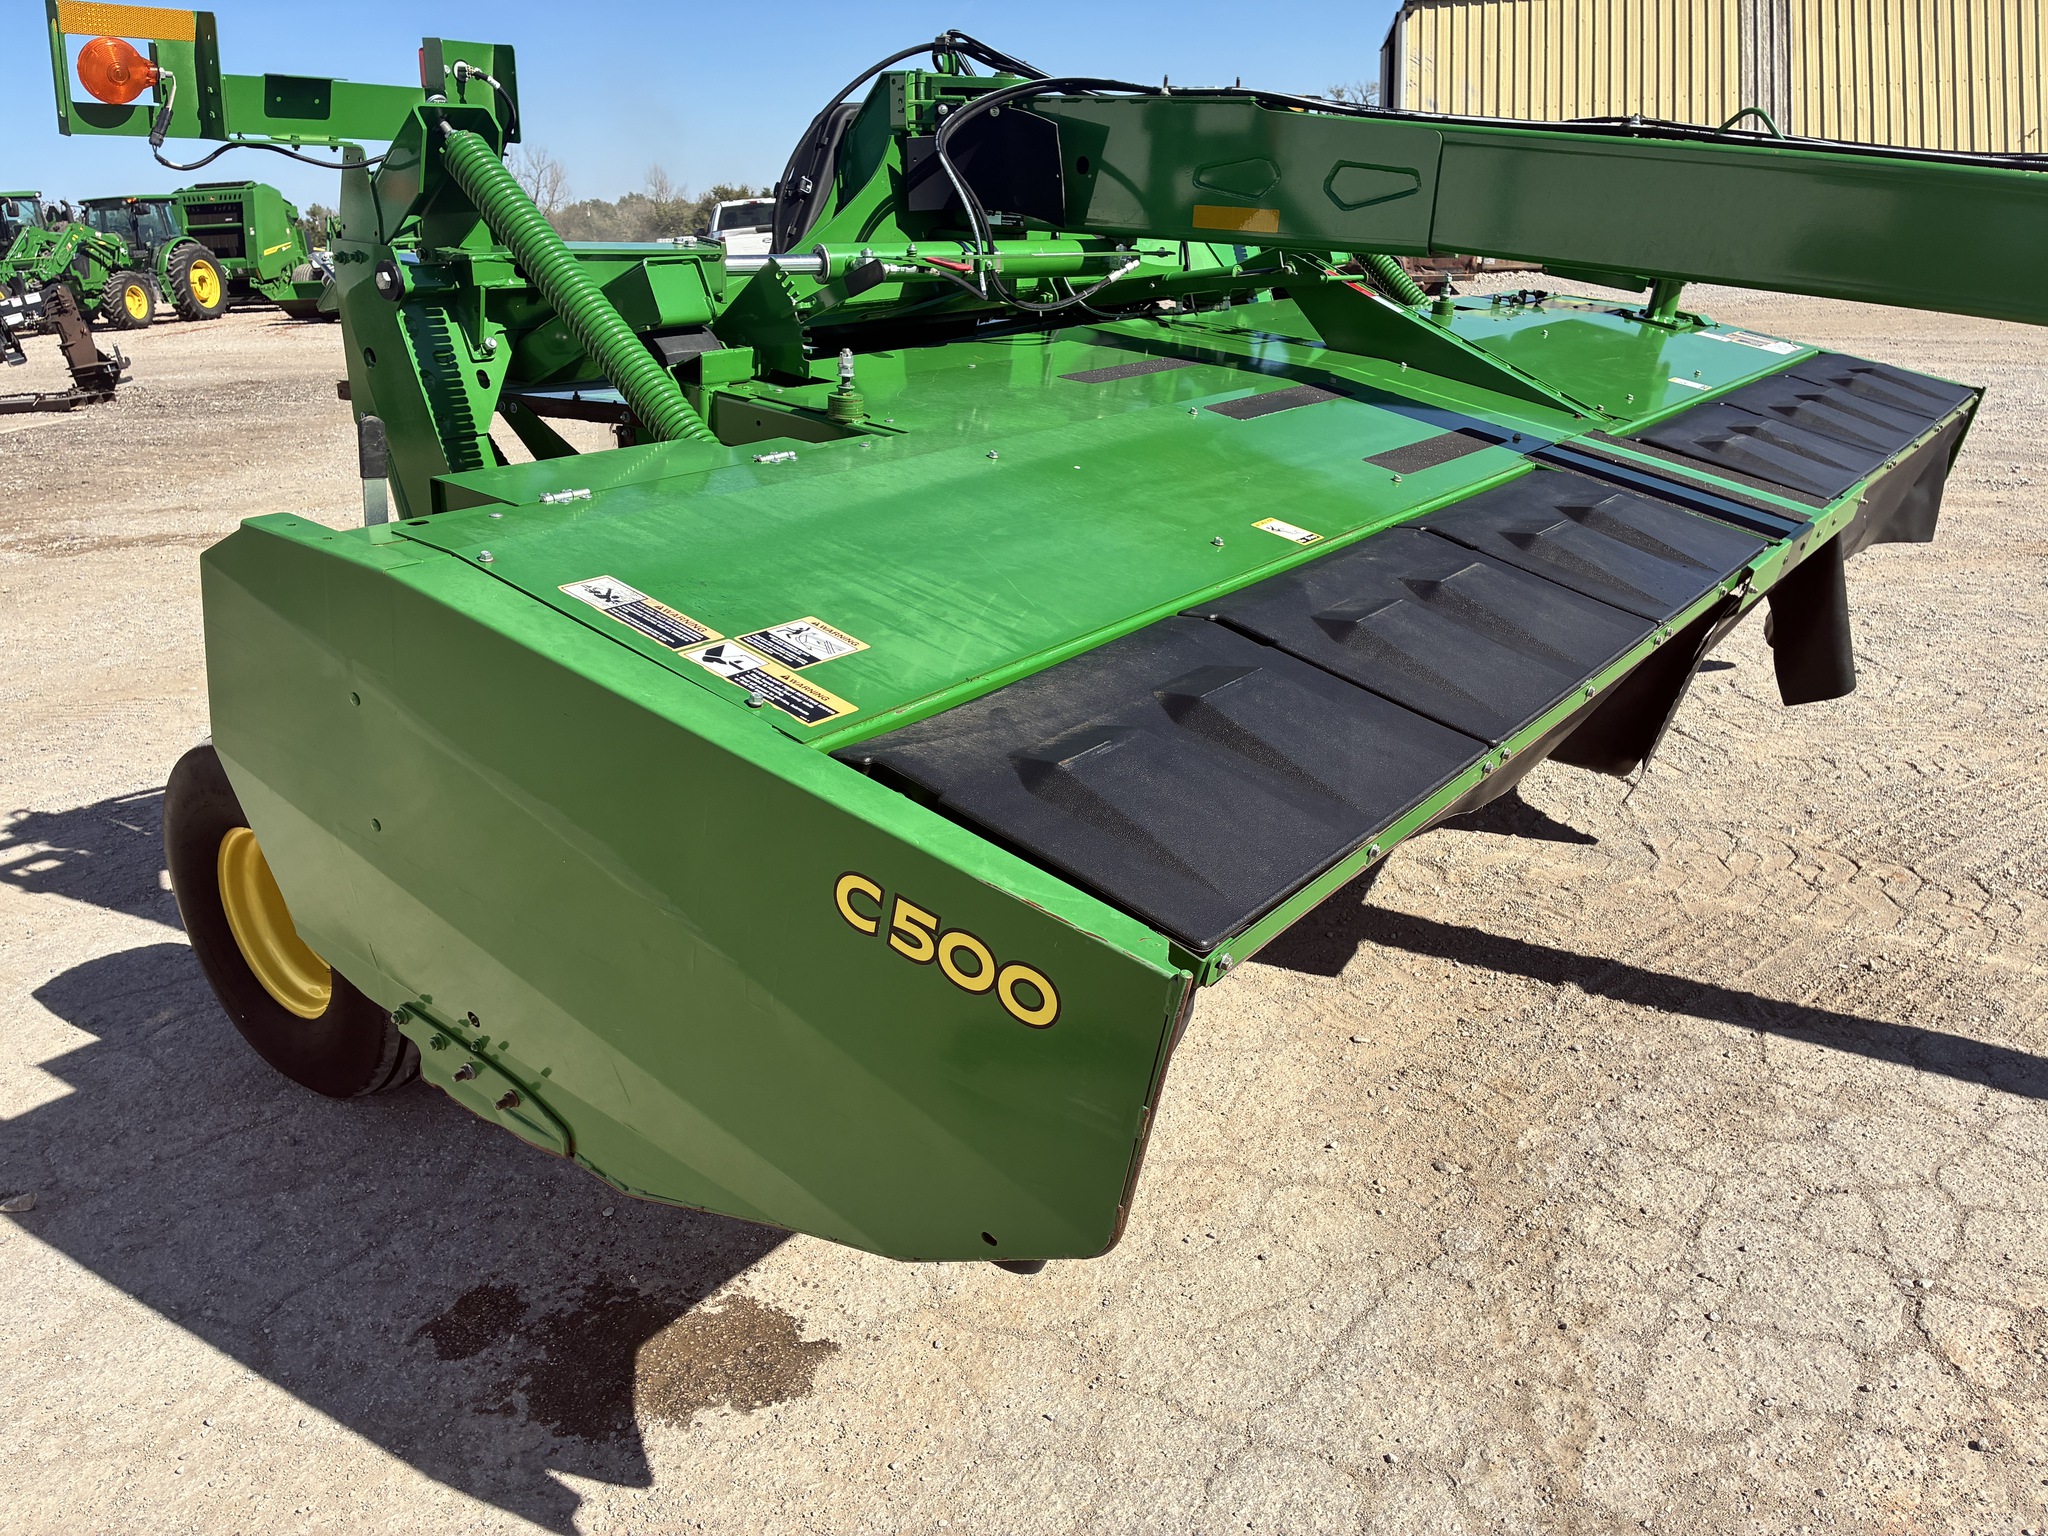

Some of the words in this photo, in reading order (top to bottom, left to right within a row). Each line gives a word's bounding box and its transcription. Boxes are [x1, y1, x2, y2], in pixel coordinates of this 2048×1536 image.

[663, 608, 707, 632] WARNING
[820, 624, 859, 646] WARNING
[790, 678, 830, 701] WARNING
